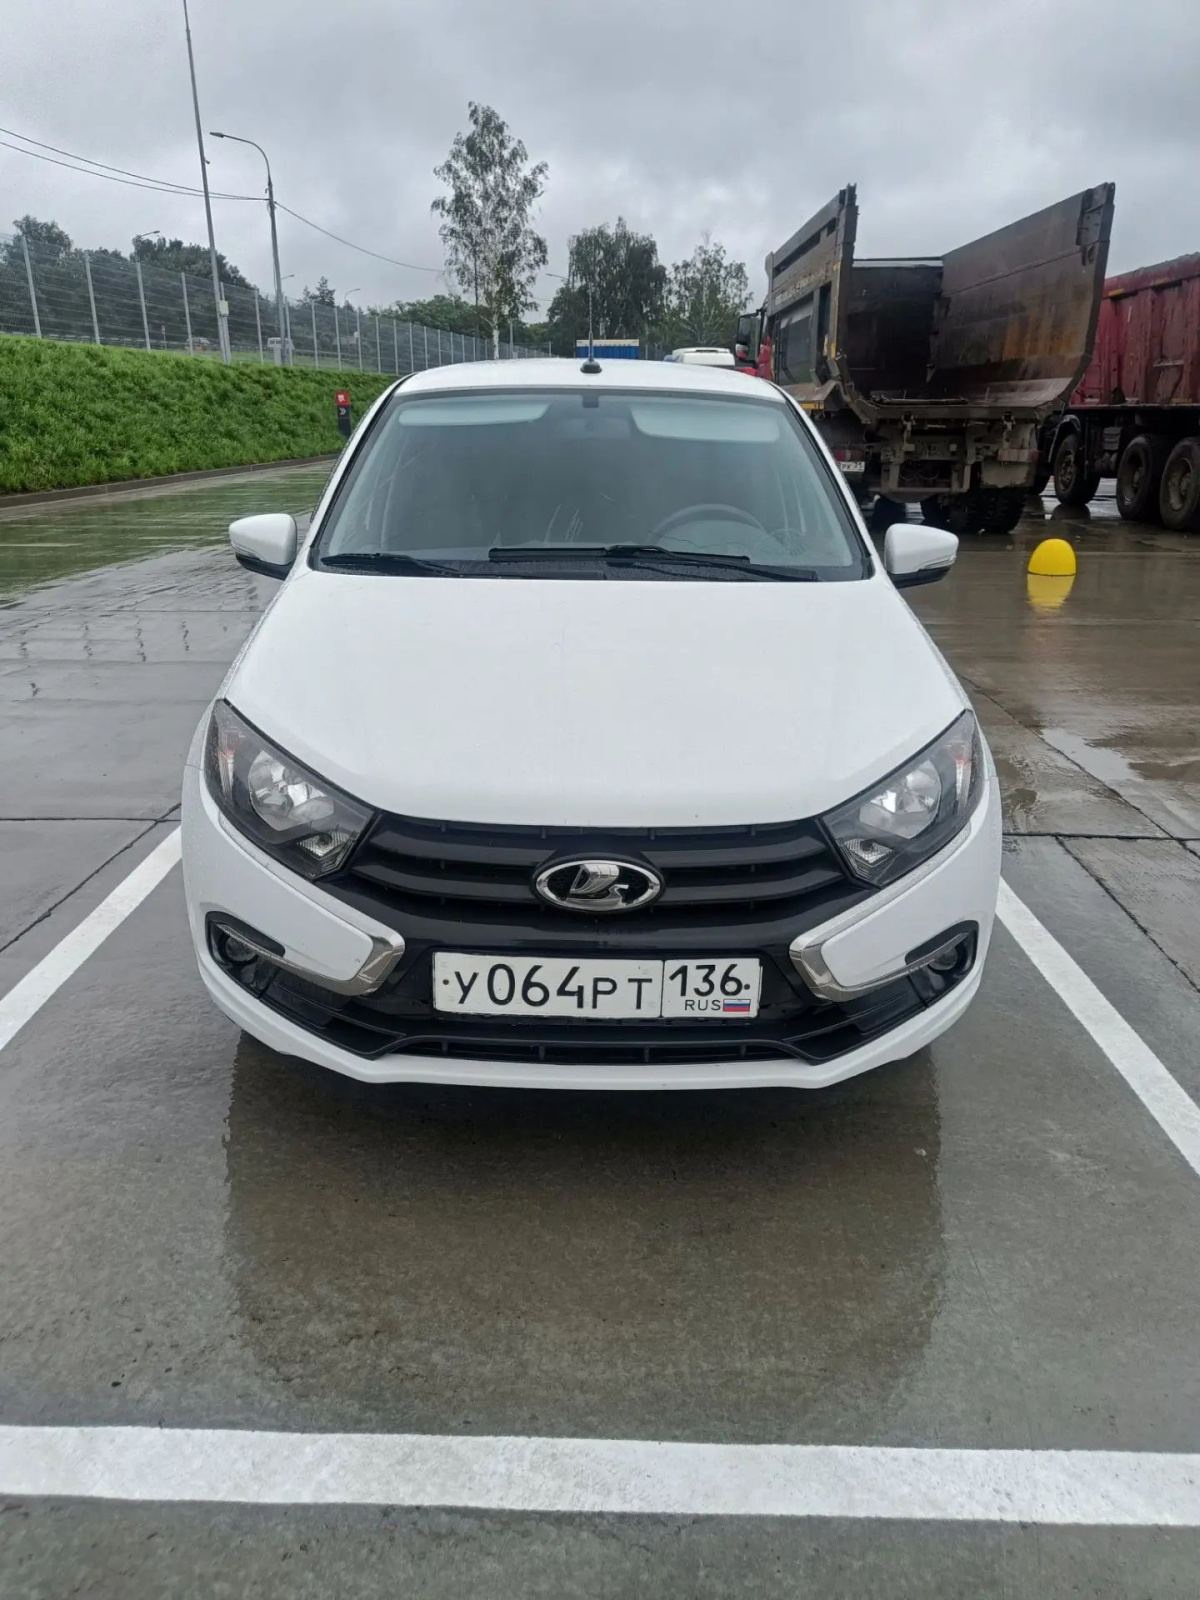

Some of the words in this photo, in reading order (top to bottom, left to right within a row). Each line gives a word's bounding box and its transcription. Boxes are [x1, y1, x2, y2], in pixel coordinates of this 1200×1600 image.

[454, 963, 653, 1009] У064РТ
[669, 964, 743, 997] 136
[684, 999, 721, 1011] RUS
